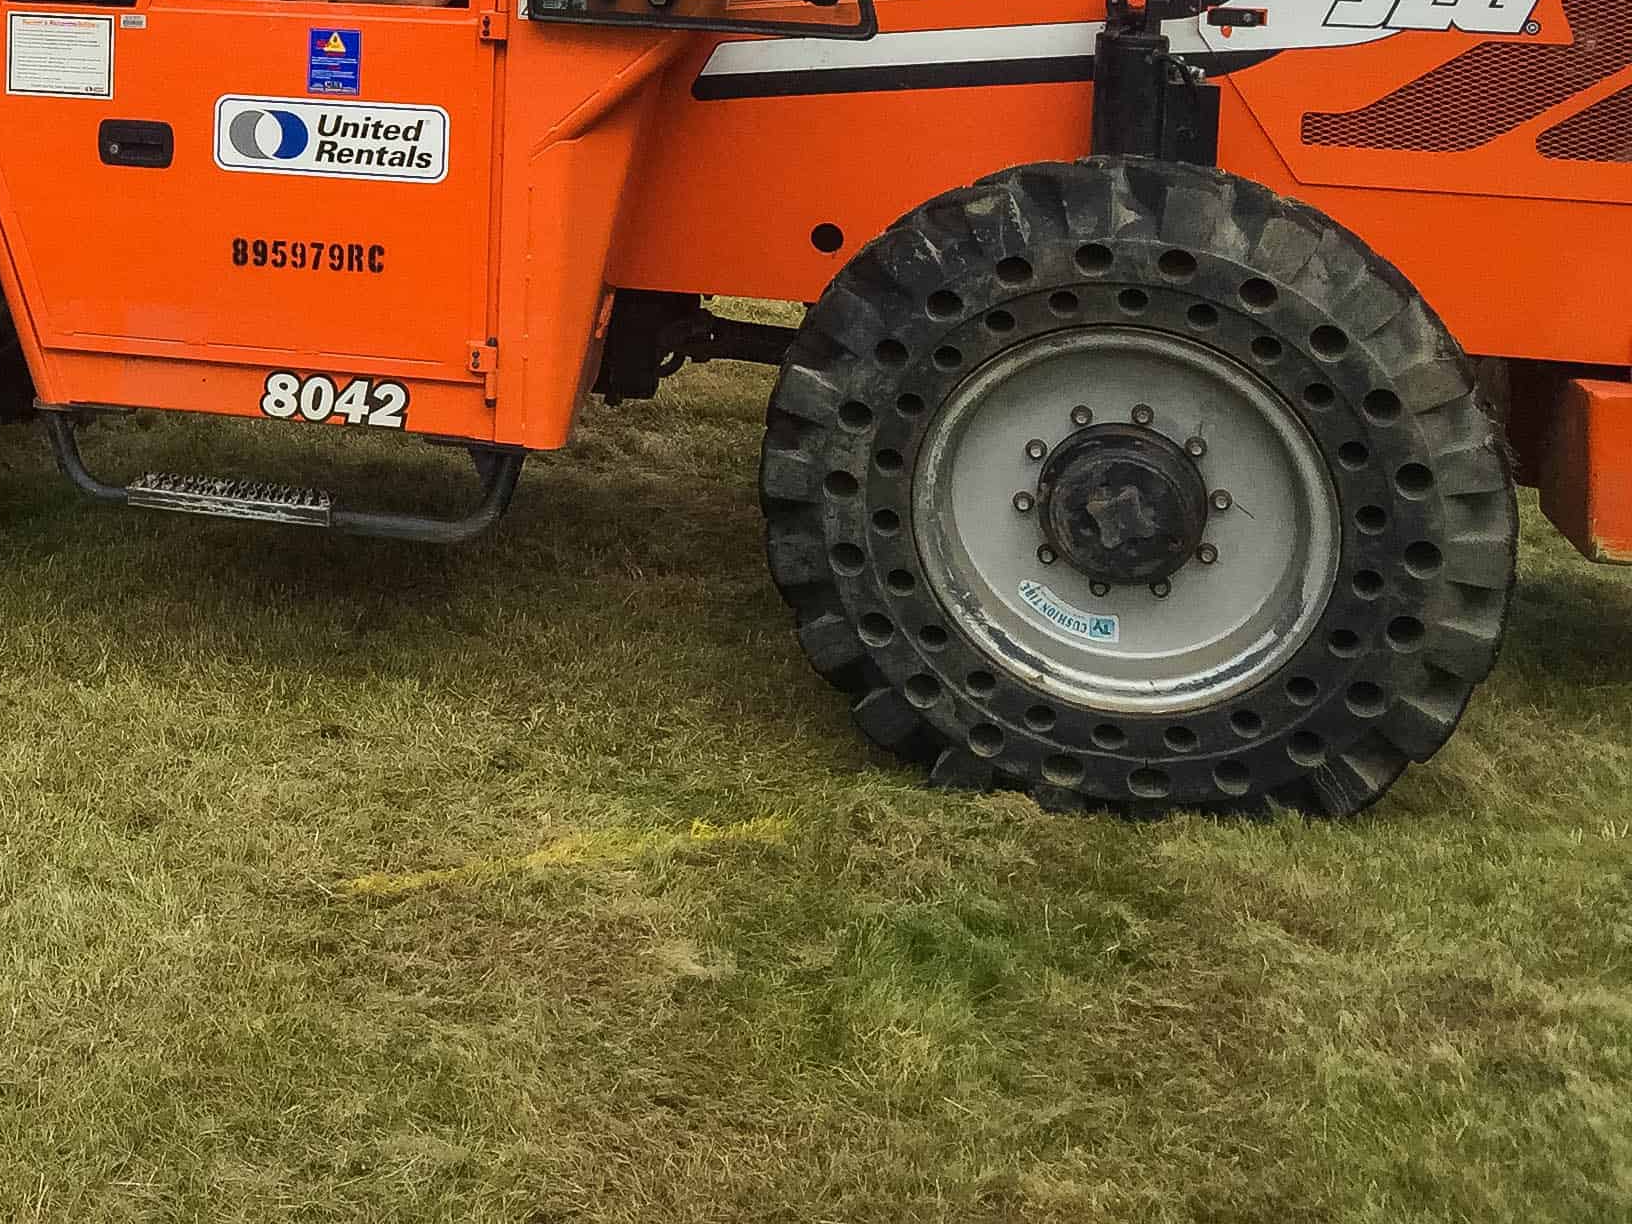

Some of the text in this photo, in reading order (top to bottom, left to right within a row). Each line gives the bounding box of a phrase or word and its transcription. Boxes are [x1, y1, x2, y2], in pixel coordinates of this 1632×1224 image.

[317, 114, 424, 141] United
[315, 140, 433, 169] Rentals
[232, 237, 385, 273] 895979RC
[261, 371, 408, 428] 8042
[1041, 602, 1087, 634] CUSHION
[1092, 618, 1112, 636] TY
